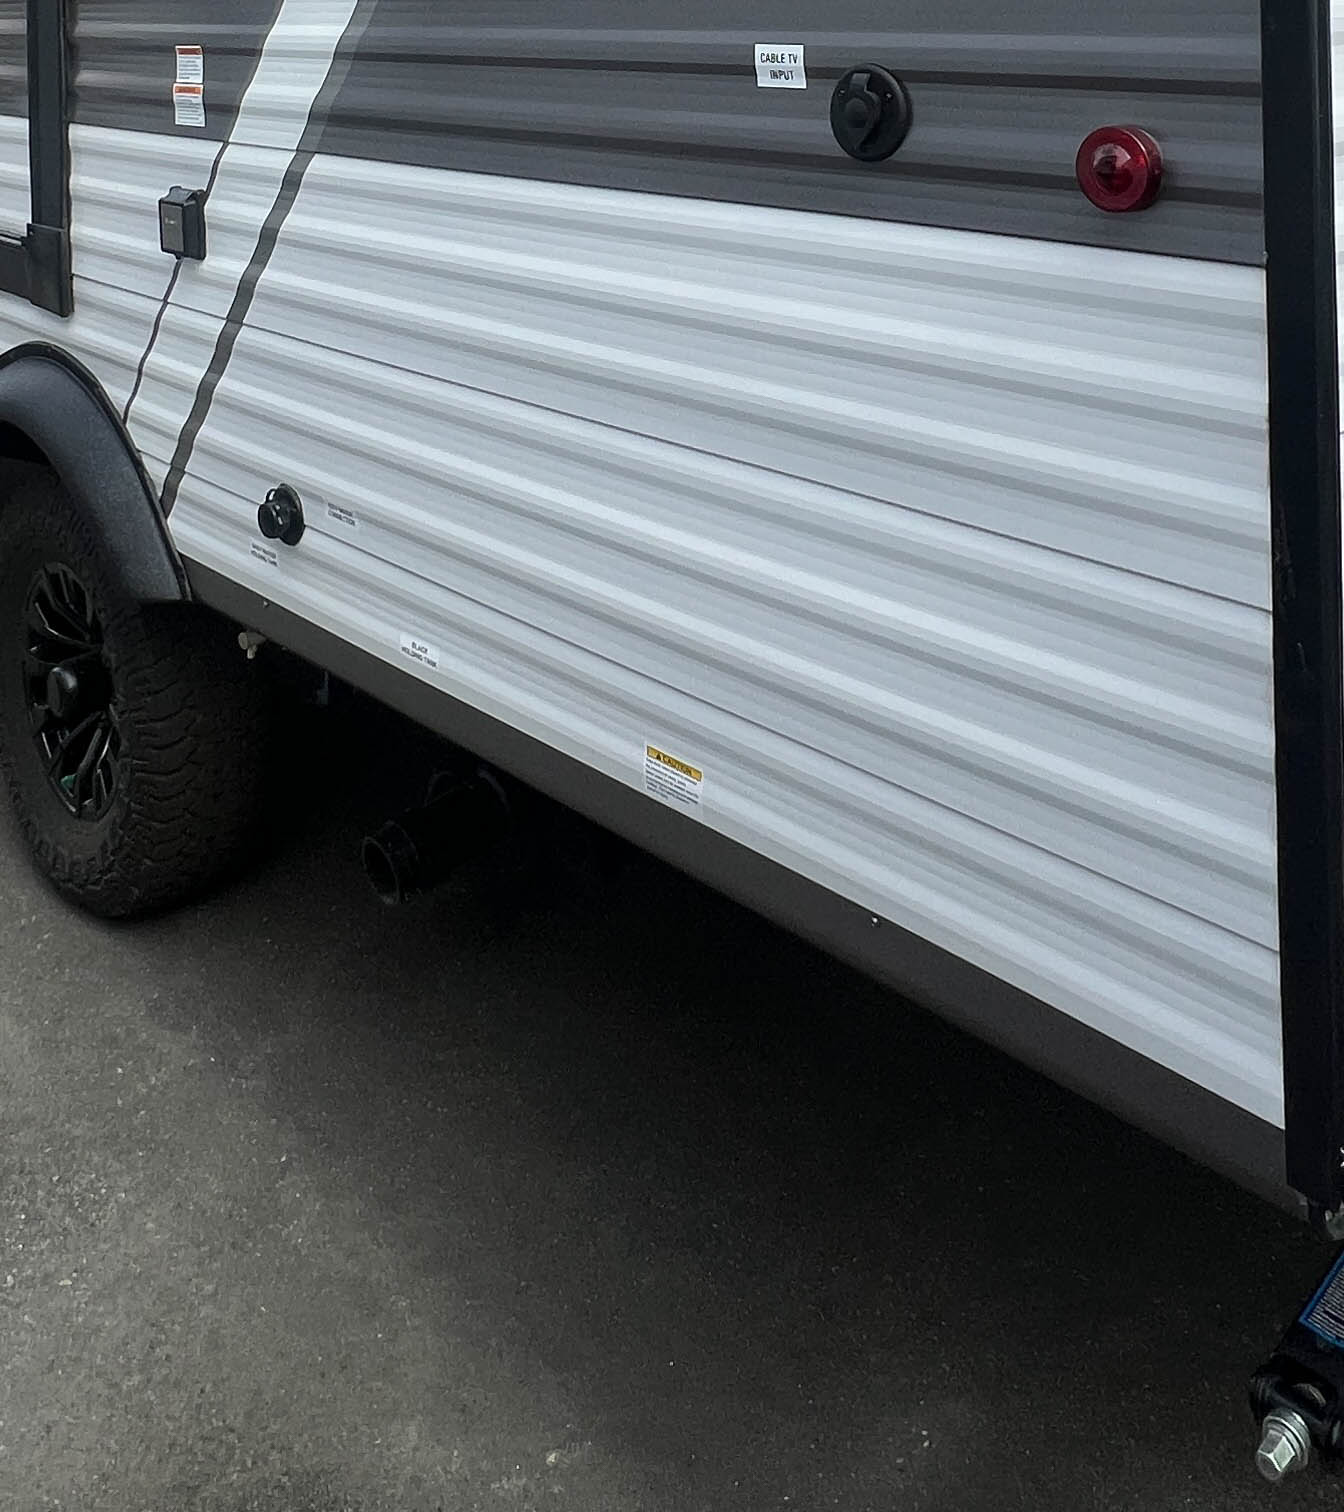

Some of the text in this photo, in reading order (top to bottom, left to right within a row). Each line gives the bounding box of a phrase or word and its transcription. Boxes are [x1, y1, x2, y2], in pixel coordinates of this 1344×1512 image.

[760, 53, 798, 64] CABLE TV
[769, 69, 794, 80] INPUT
